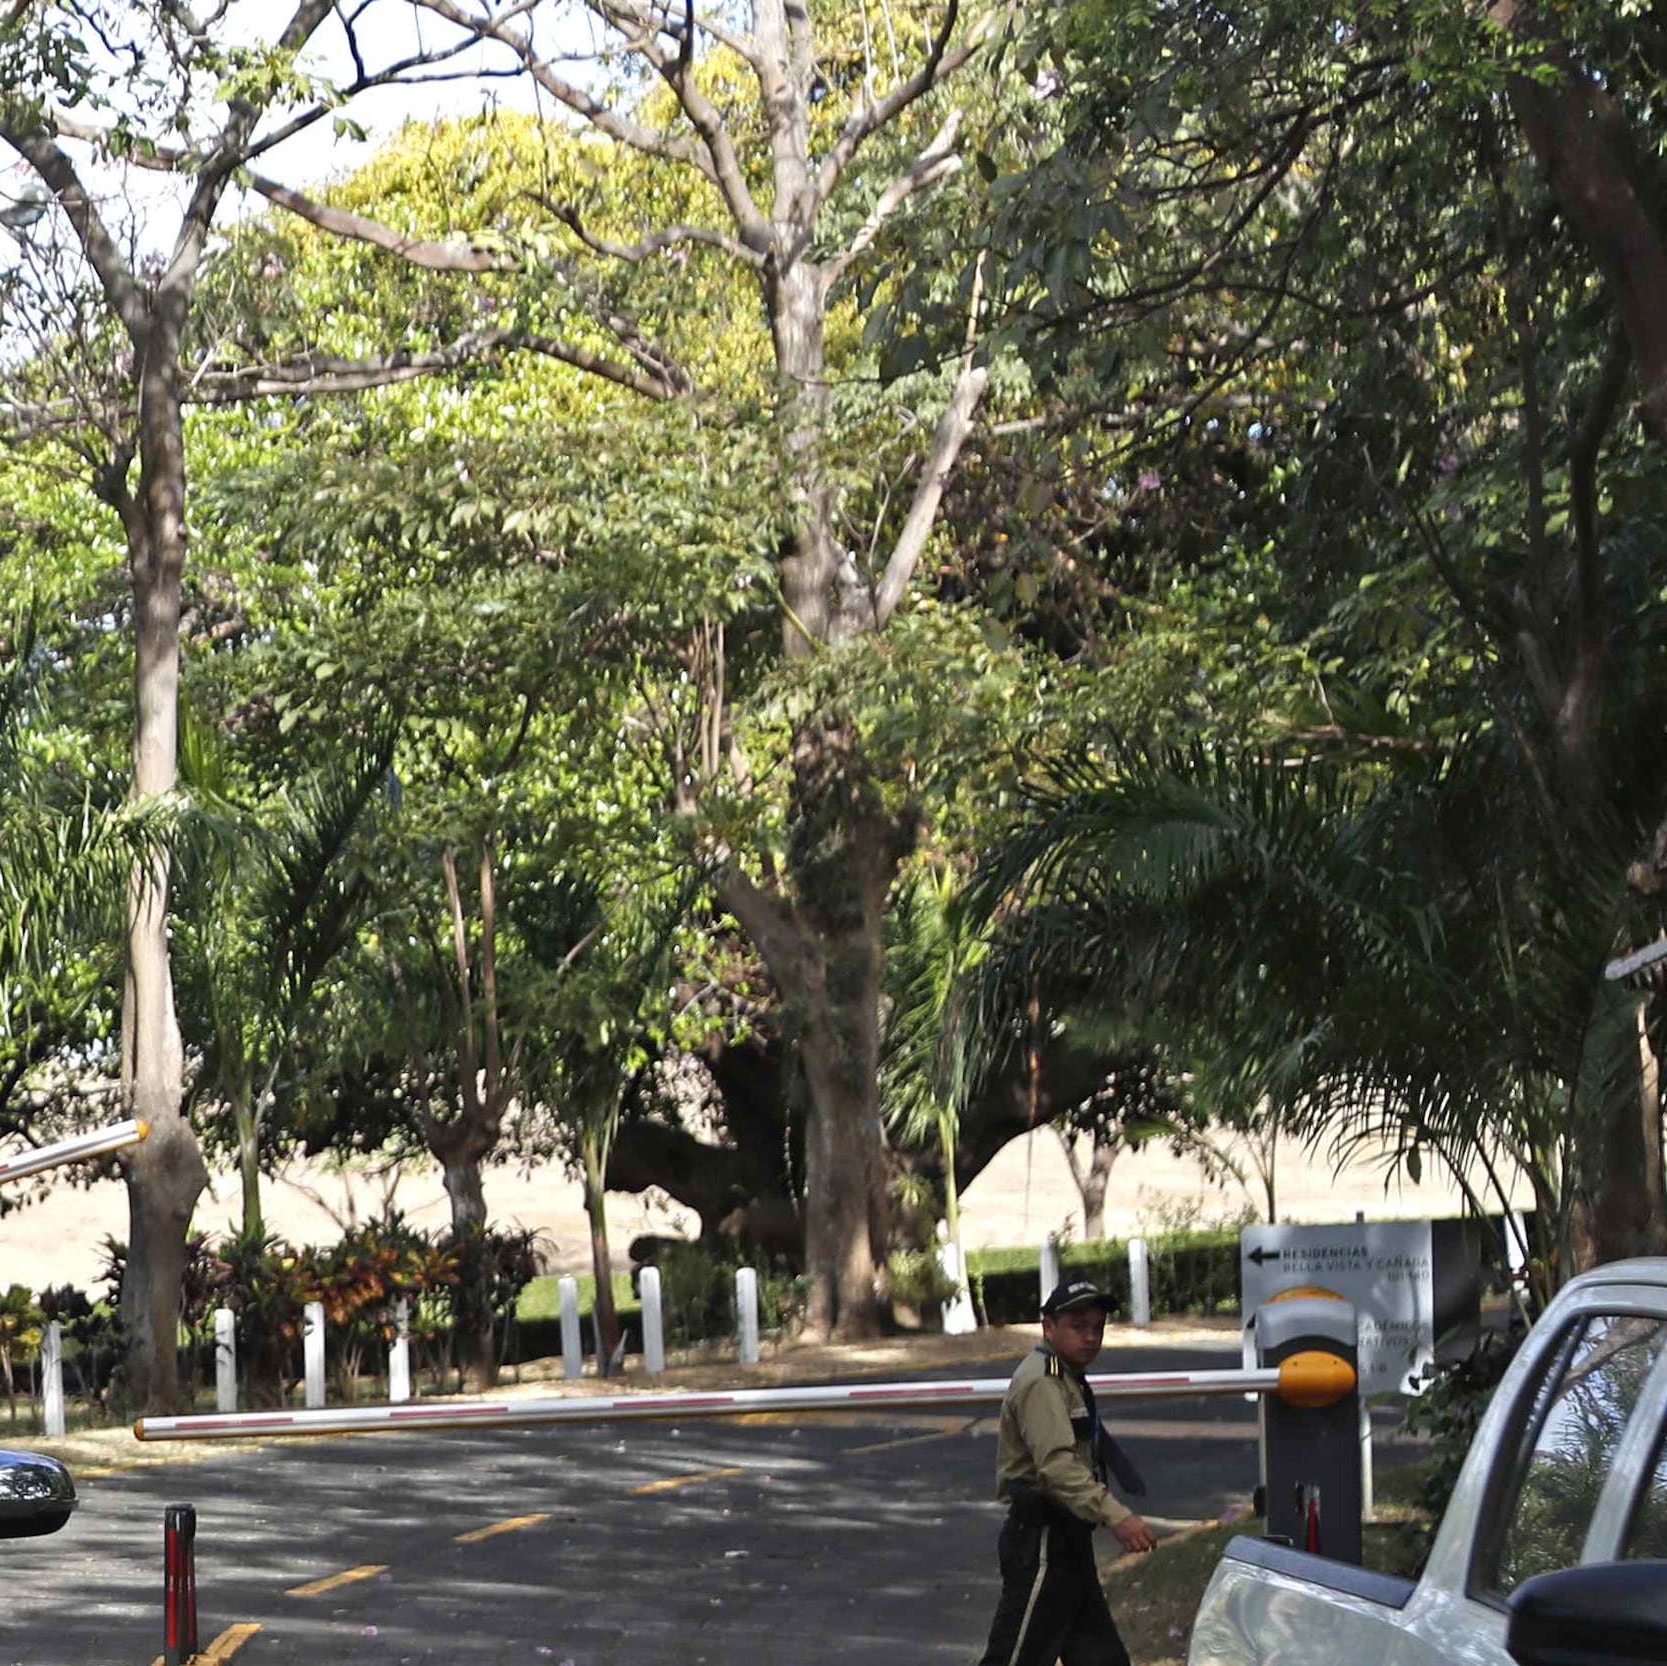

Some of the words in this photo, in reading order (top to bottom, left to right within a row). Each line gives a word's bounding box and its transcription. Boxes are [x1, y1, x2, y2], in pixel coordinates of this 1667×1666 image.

[1282, 1246, 1368, 1259] RESIDENCIAS
[1283, 1261, 1323, 1273] BELLA
[1327, 1259, 1361, 1272] VISTA
[1365, 1258, 1373, 1270] Y
